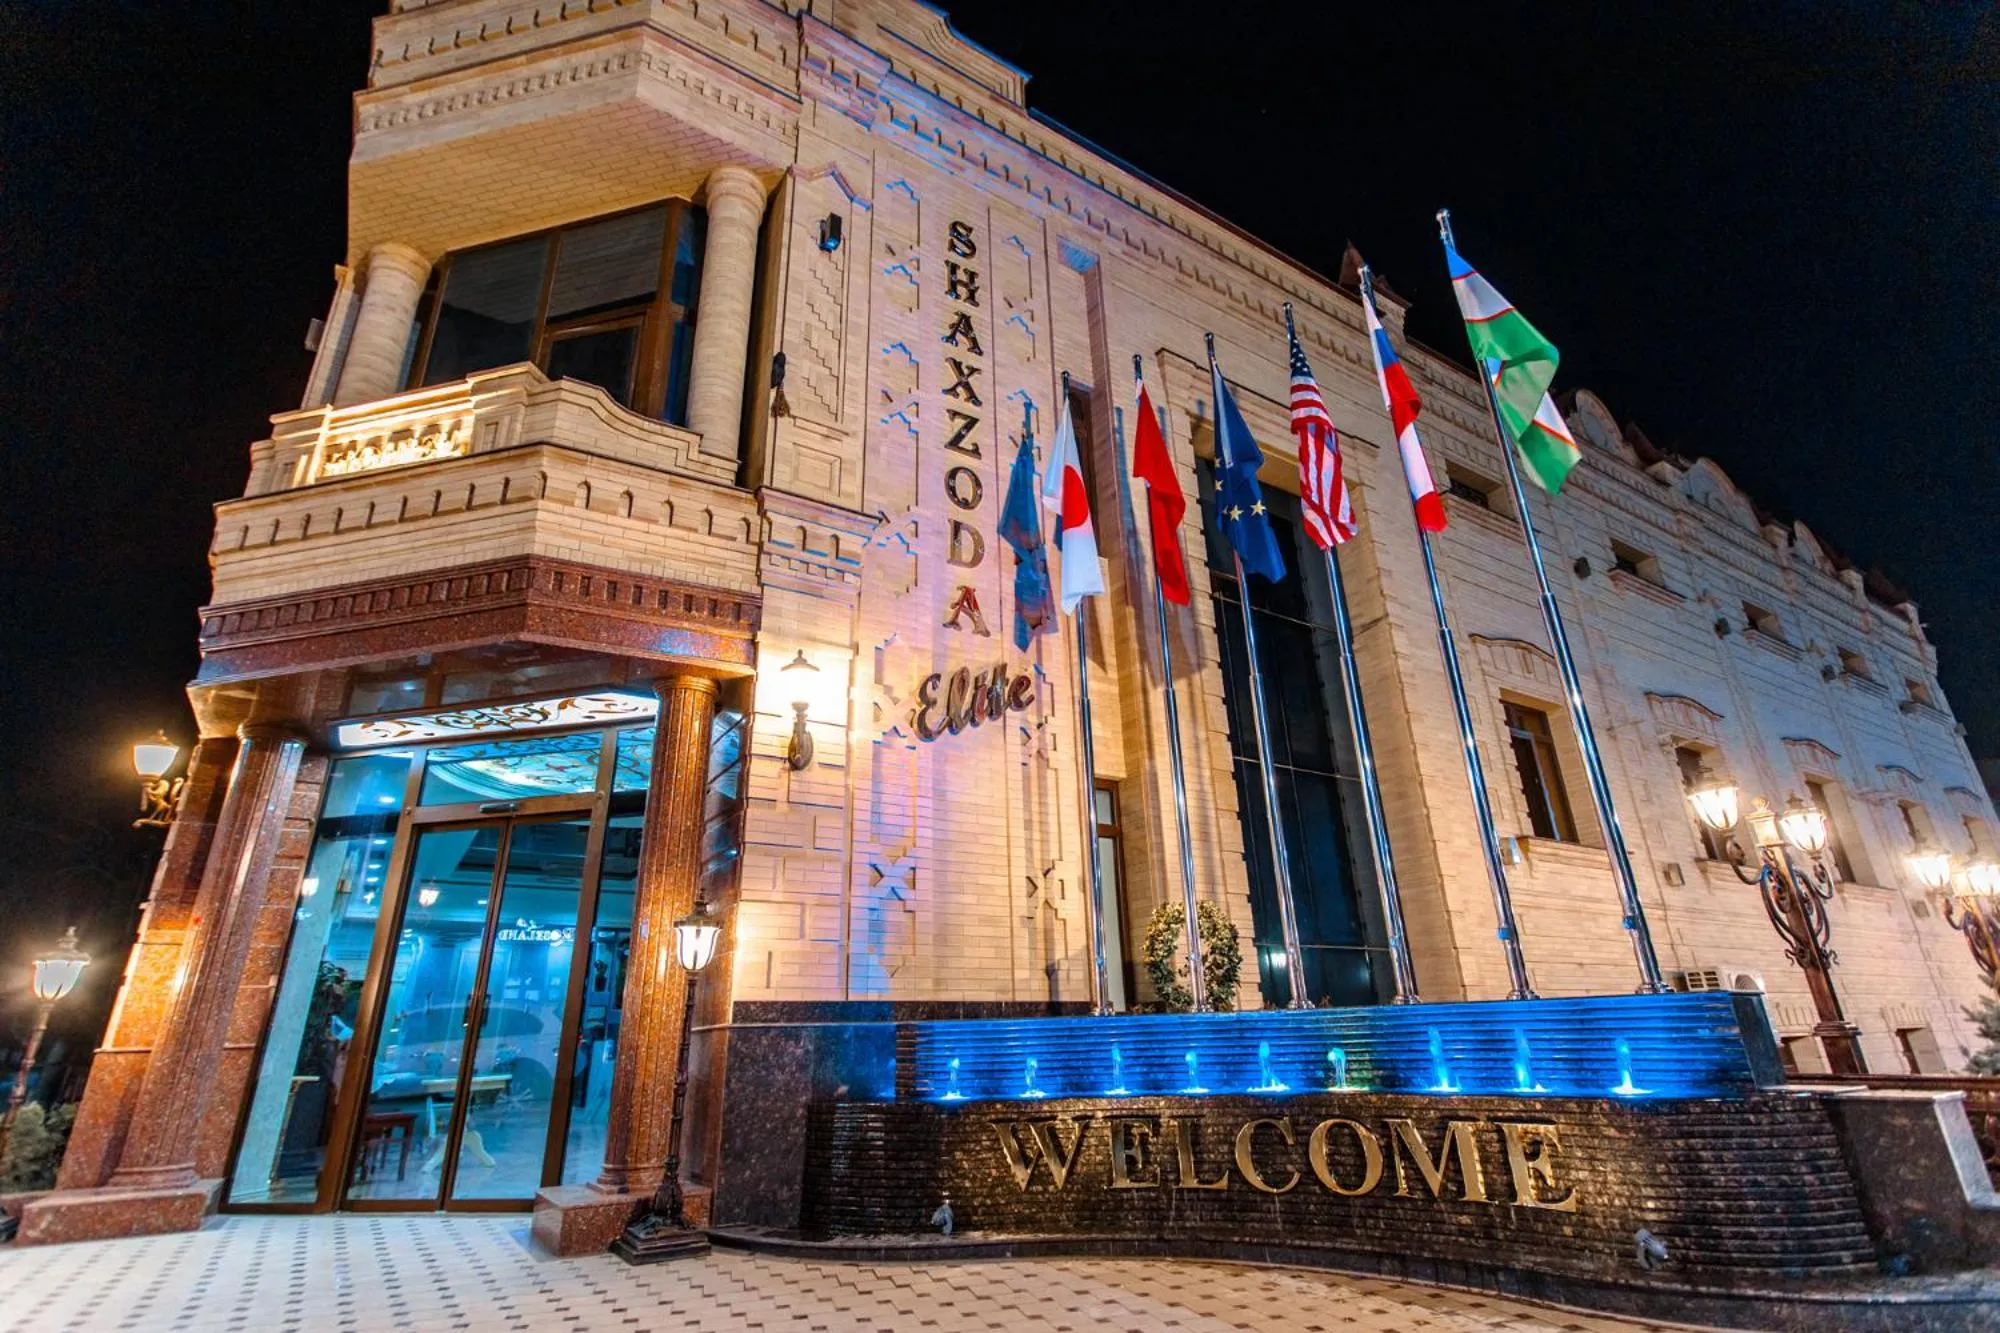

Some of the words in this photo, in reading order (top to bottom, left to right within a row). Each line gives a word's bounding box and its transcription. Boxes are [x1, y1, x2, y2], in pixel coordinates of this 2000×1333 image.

[941, 220, 990, 637] SHAXZODA
[911, 663, 1035, 742] Elite
[988, 1115, 1577, 1213] WELCOME
